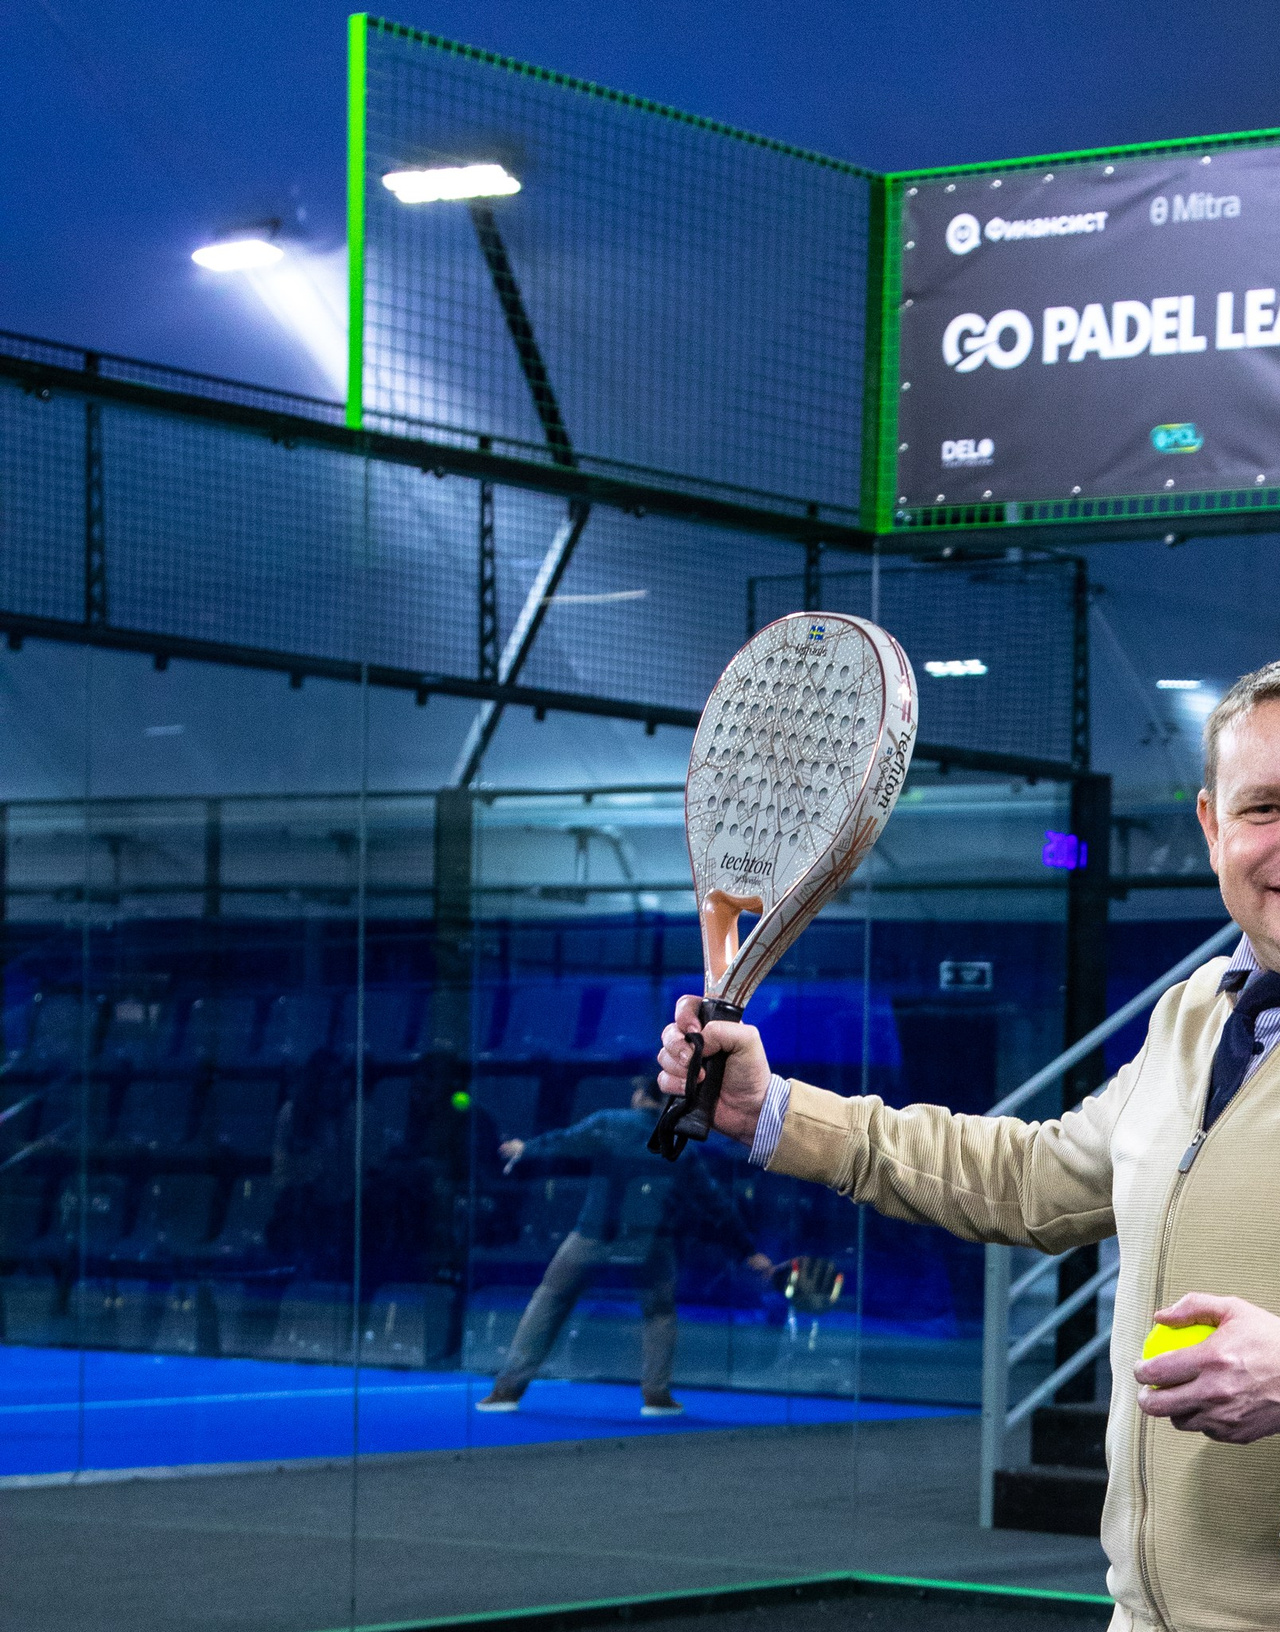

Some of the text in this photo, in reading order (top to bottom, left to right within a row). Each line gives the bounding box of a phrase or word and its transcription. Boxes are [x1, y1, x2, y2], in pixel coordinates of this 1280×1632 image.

[1172, 191, 1242, 222] Mitra
[984, 211, 1109, 243] Финансист
[942, 309, 1034, 373] GO
[1042, 295, 1207, 364] PADEL
[878, 731, 912, 809] techton
[720, 852, 773, 876] techton
